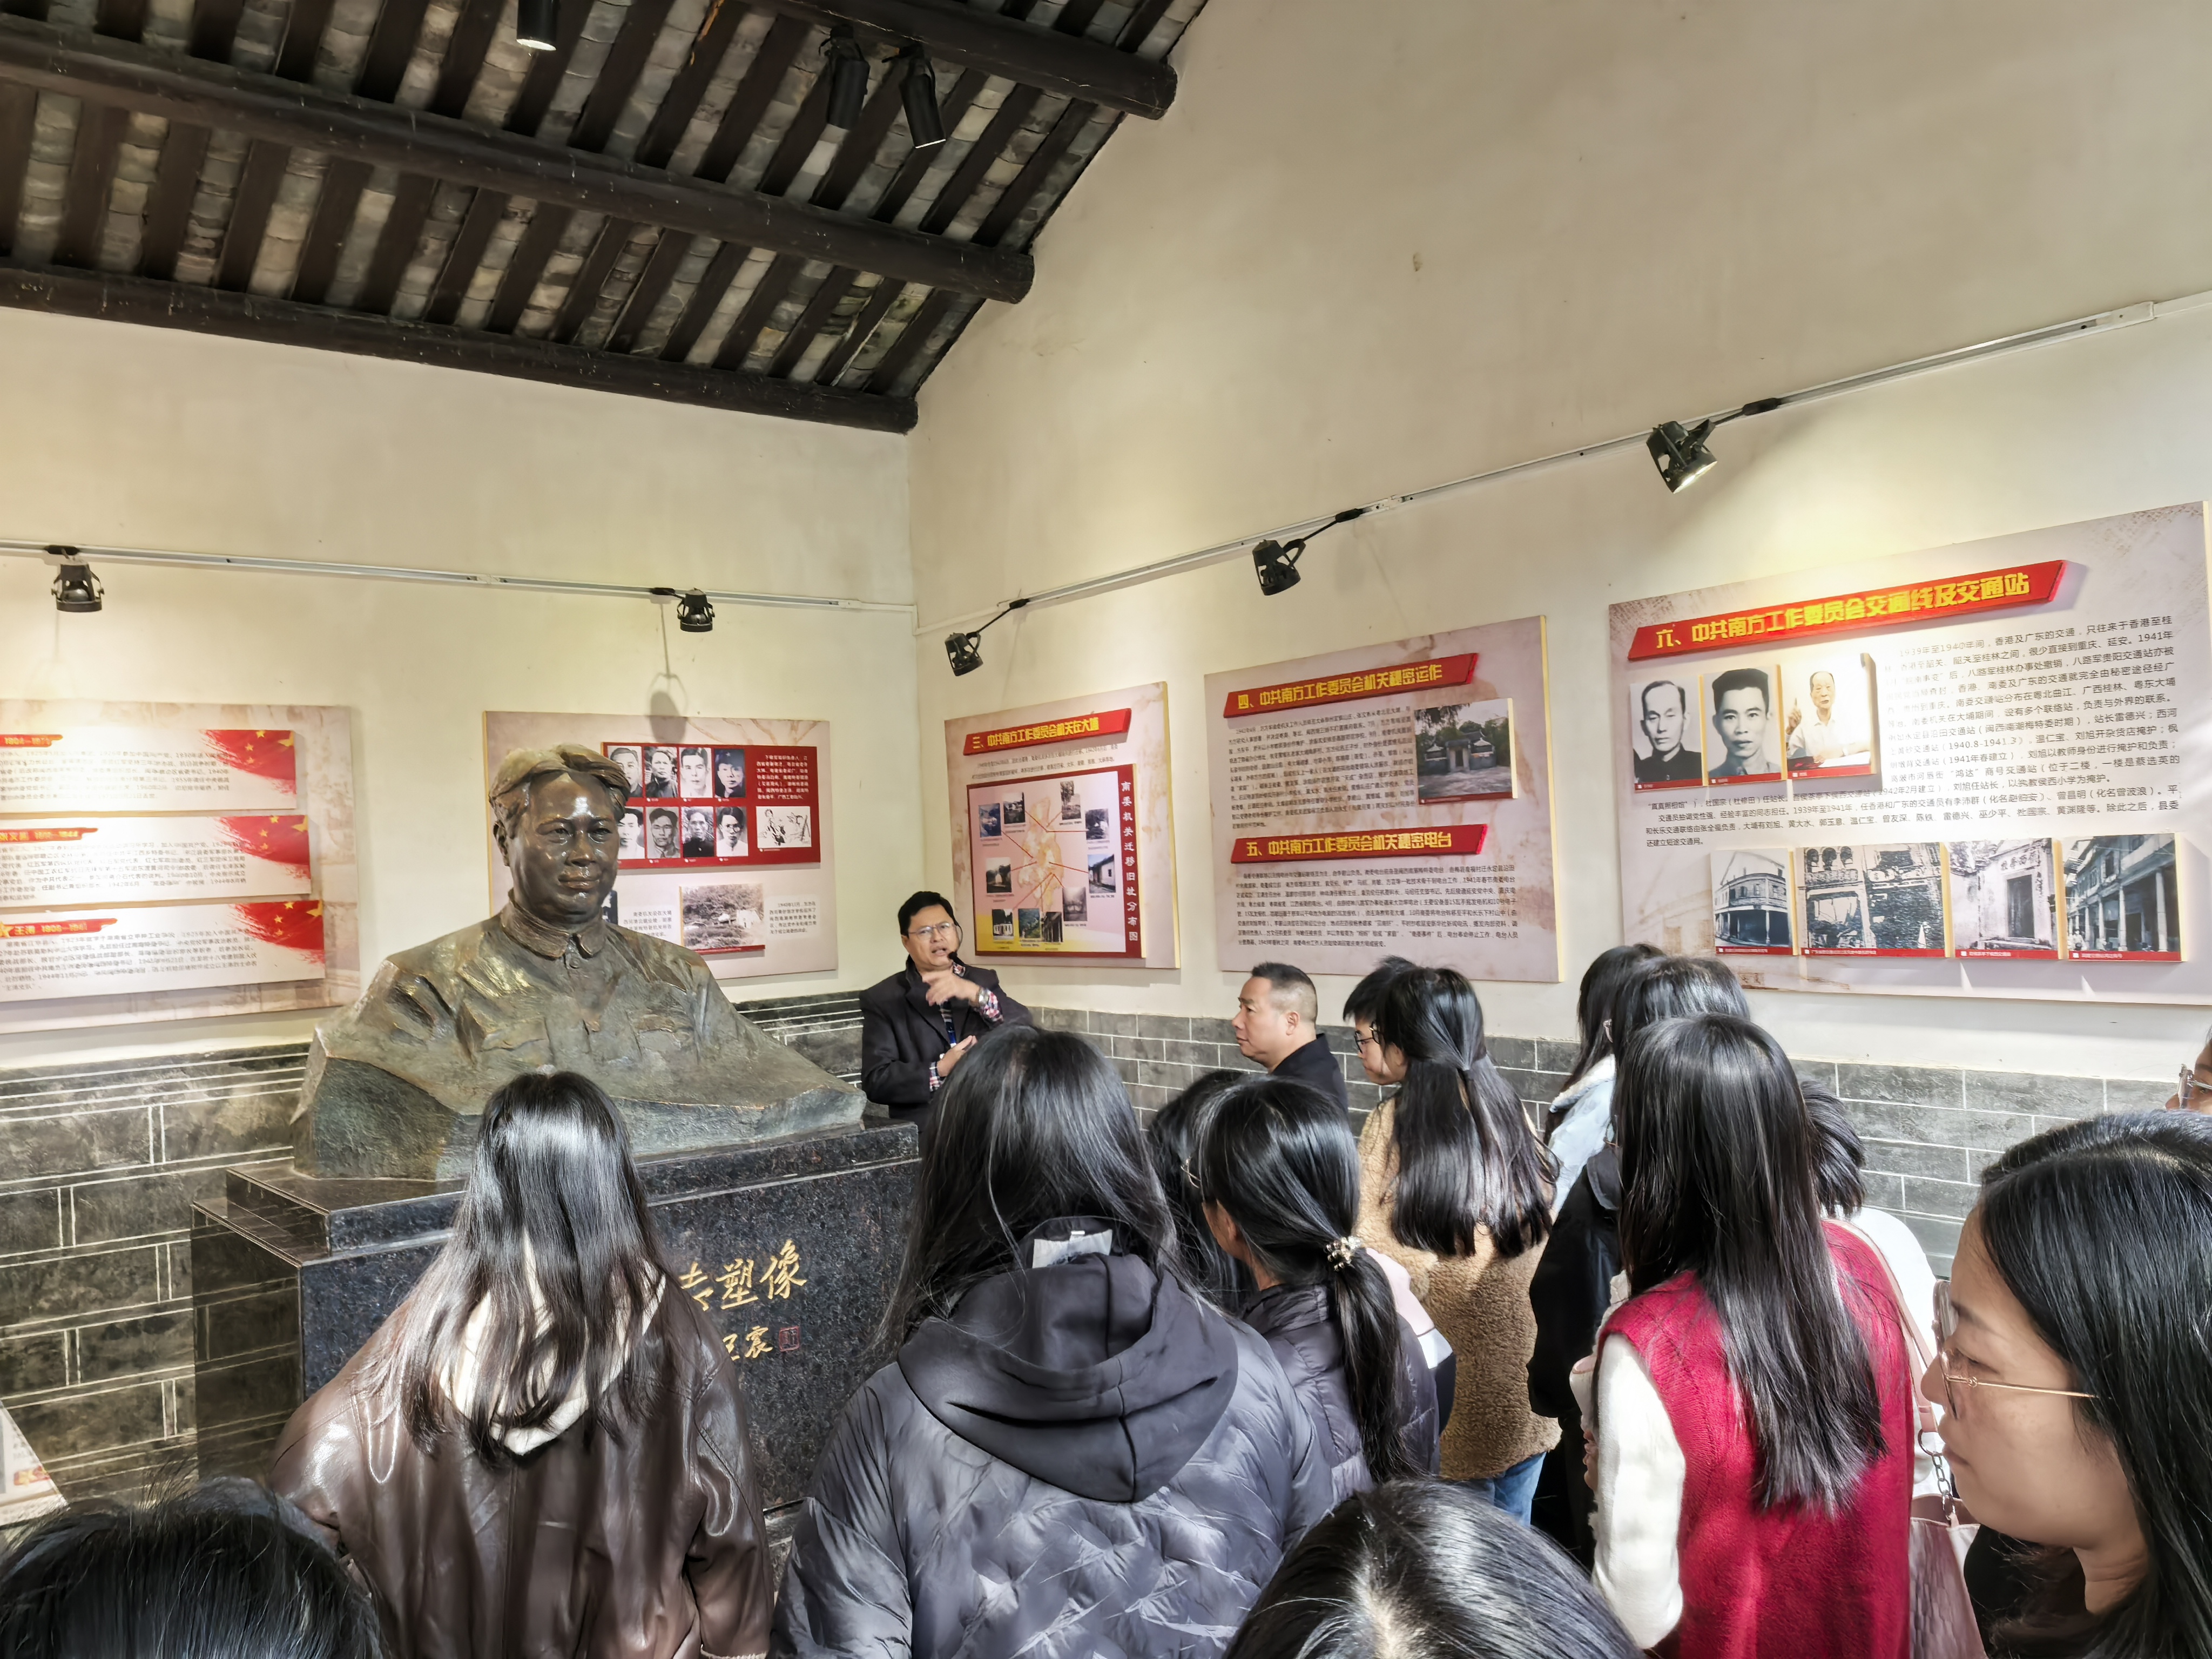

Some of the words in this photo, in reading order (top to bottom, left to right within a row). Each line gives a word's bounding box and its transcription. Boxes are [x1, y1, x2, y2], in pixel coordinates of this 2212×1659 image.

[1655, 572, 2029, 649] 六、中共南方工作委员会交通线及交通站
[1238, 664, 1442, 709] 四、中共南方工作委员会机关秘密运作
[1121, 781, 1138, 941] 南委机关迁移旧址分布图
[1246, 832, 1451, 857] 五、中共南方工作委员会机关秘密电台
